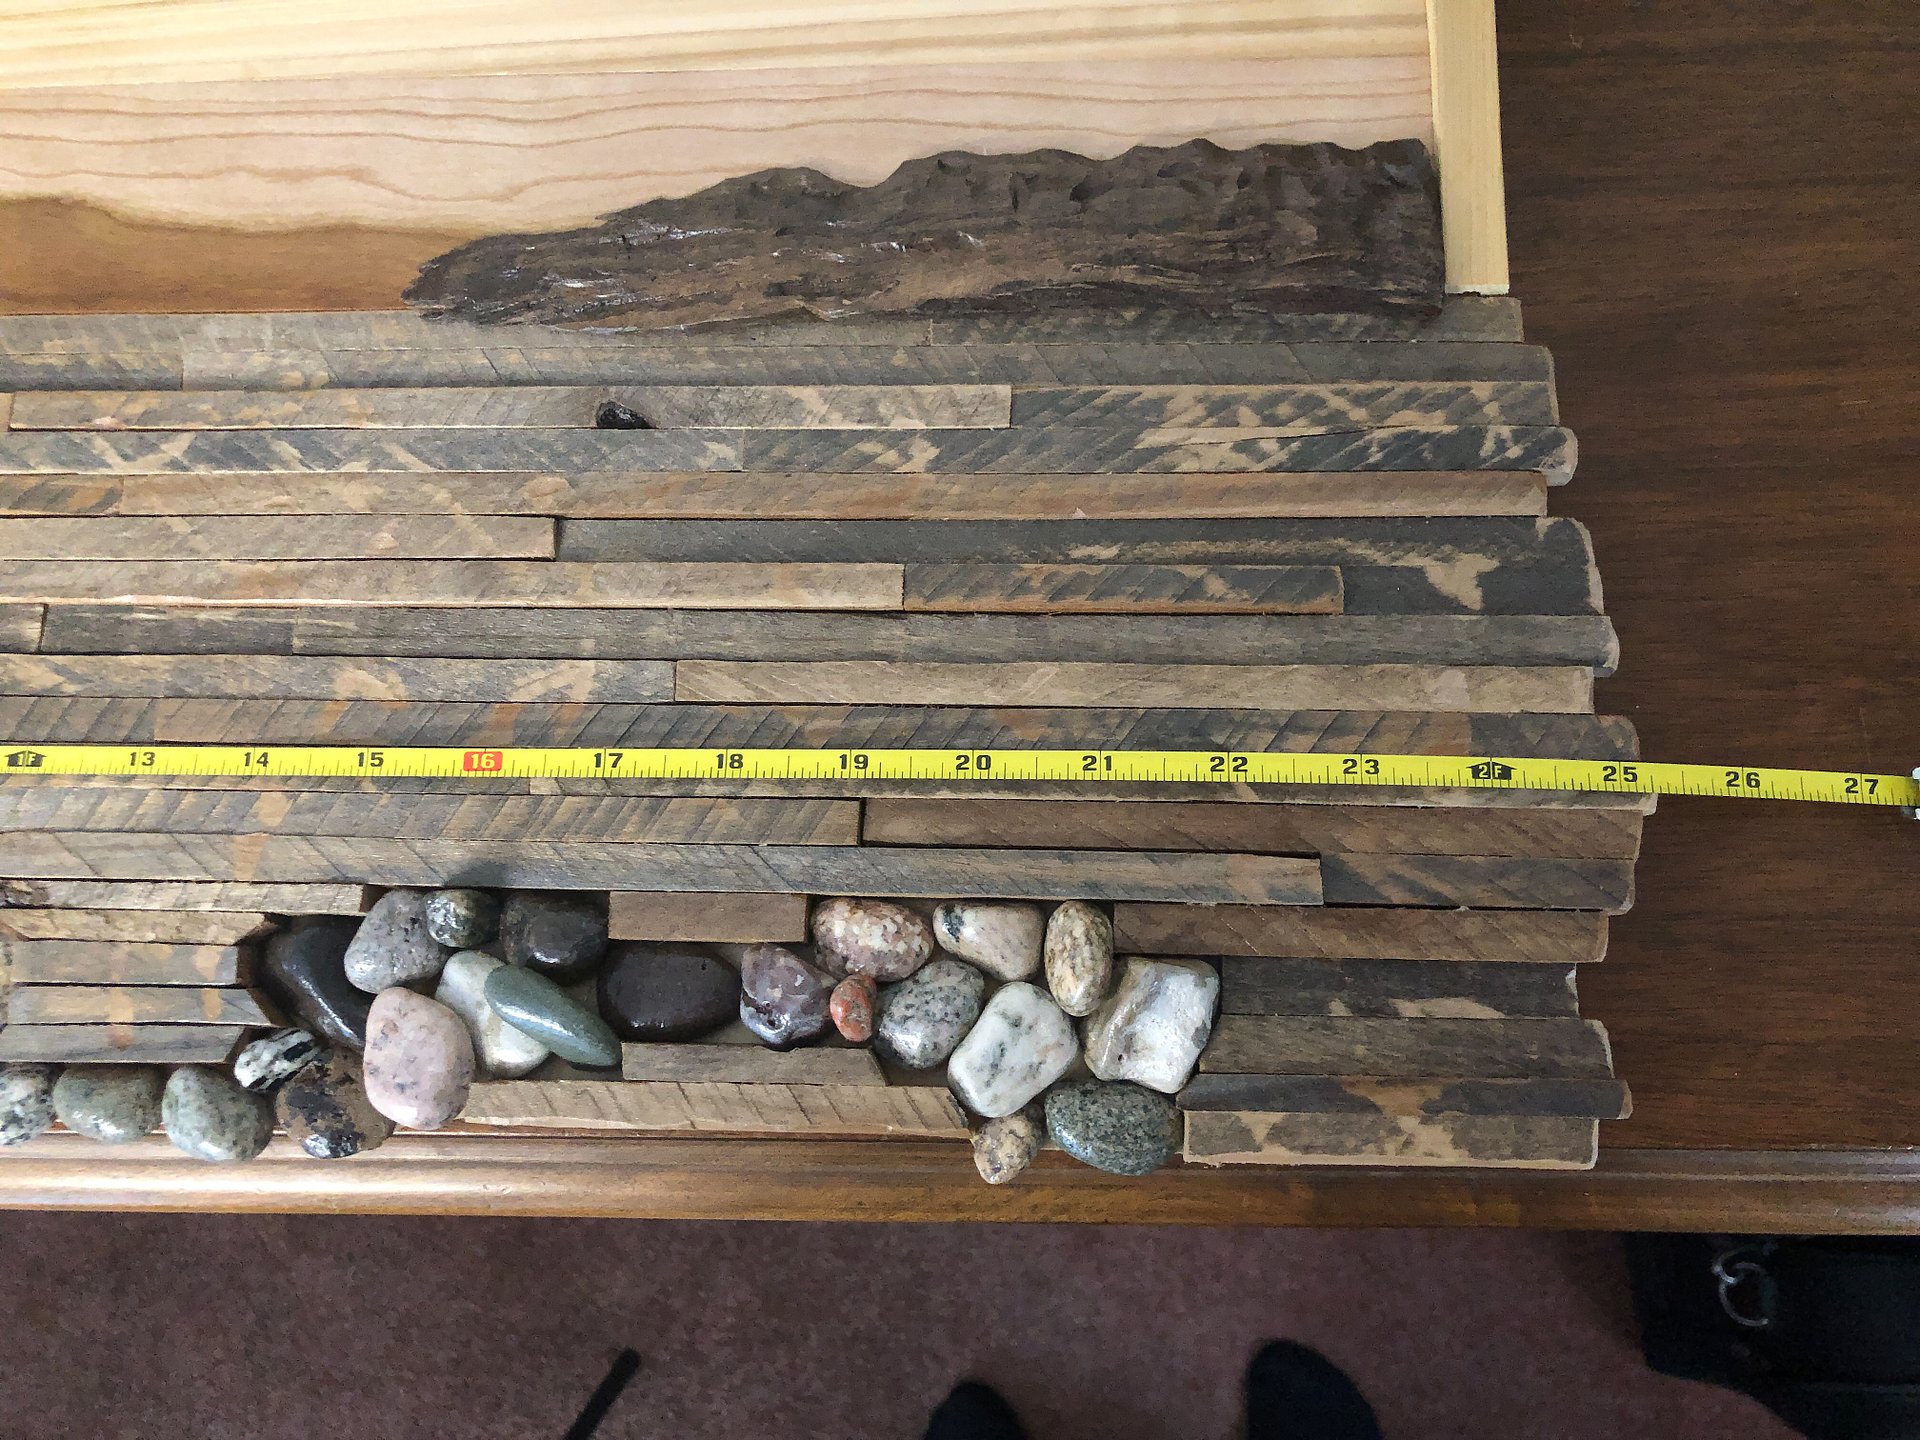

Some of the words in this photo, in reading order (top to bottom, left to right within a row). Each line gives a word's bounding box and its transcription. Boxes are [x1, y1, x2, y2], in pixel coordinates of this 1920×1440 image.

[129, 752, 156, 767] 13
[244, 752, 269, 768] 14
[357, 752, 384, 767] 15
[471, 753, 495, 769] 16
[594, 753, 623, 769] 17
[716, 753, 744, 769] 18
[839, 754, 869, 770] 19
[955, 755, 992, 770] 20
[1082, 755, 1112, 771] 21
[1209, 756, 1248, 772] 22
[1342, 758, 1380, 775] 23
[1479, 765, 1502, 778] 2F
[1602, 765, 1638, 783] 25
[1725, 771, 1761, 788] 26
[1844, 777, 1879, 795] 27
